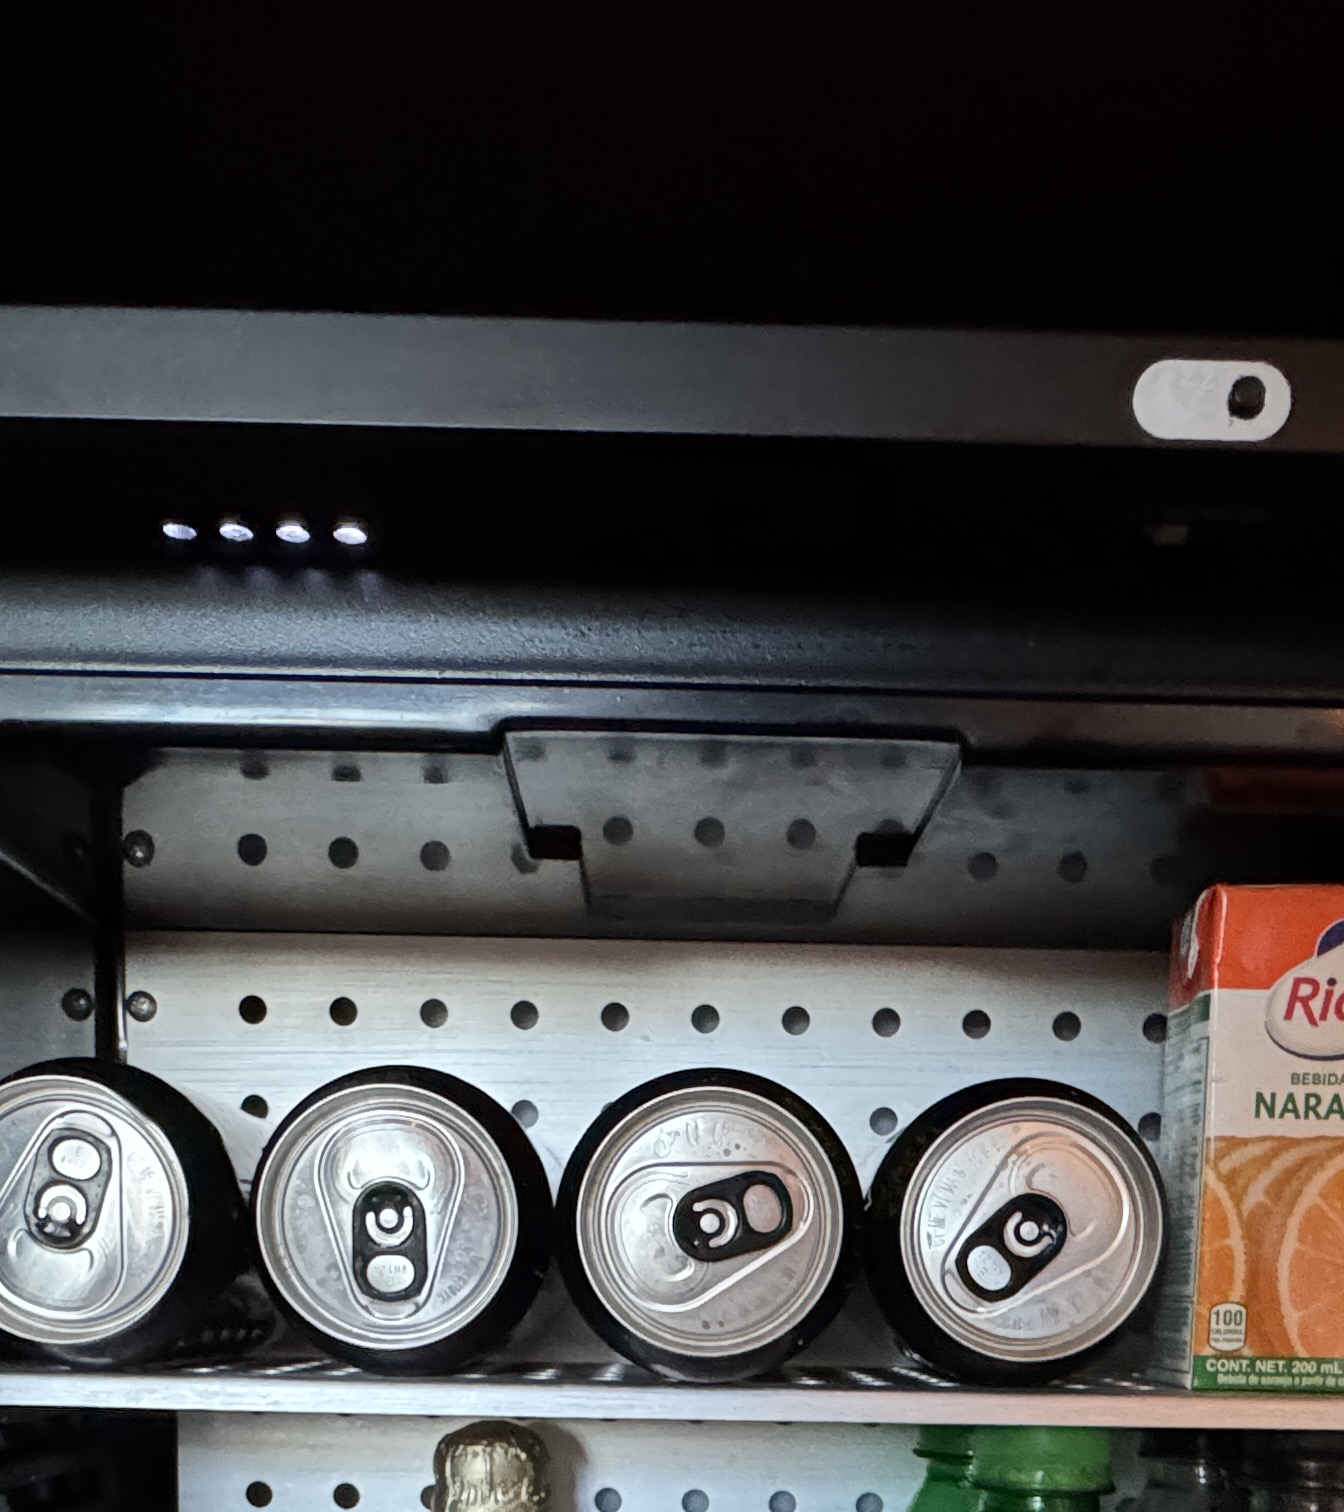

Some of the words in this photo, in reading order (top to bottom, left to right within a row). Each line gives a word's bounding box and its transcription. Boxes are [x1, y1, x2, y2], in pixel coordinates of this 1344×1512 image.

[1213, 1309, 1244, 1327] 100
[1206, 1359, 1251, 1373] CONT.
[1256, 1360, 1288, 1373] NET.
[1291, 1361, 1316, 1374] 200
[1320, 1362, 1343, 1375] mL
